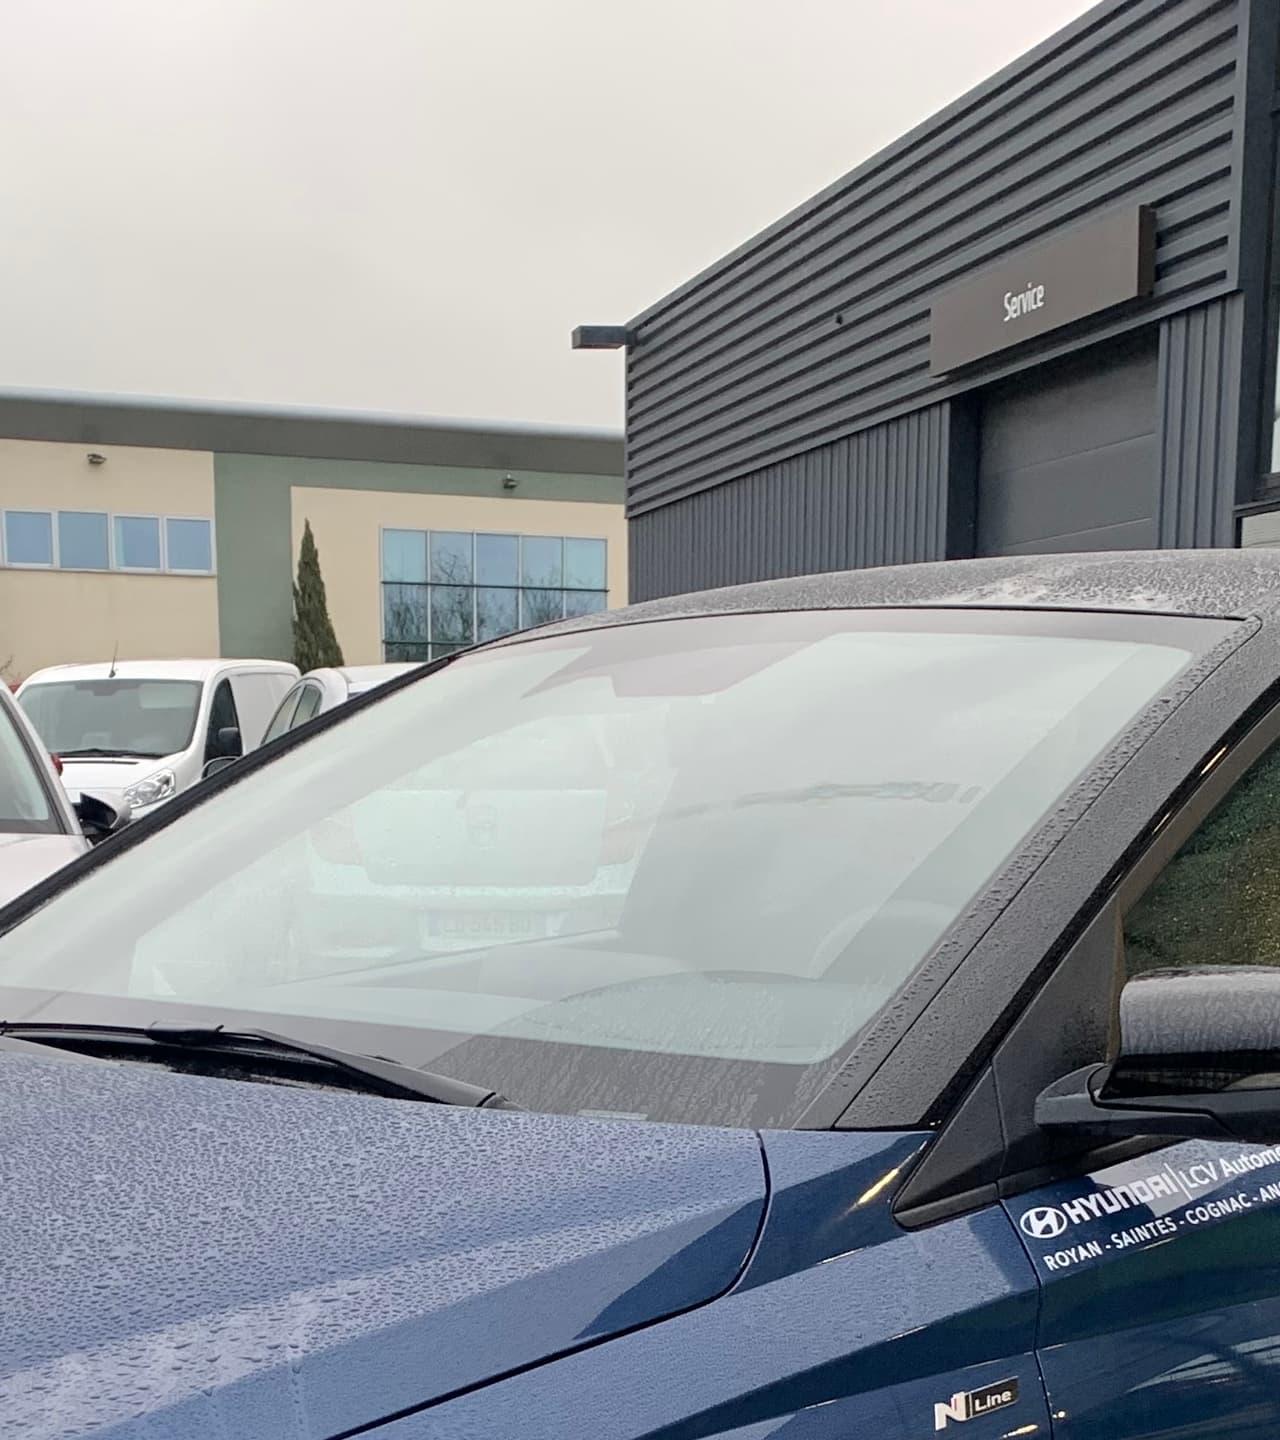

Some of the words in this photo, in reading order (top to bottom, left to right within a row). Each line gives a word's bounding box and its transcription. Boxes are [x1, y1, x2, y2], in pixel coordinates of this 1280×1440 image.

[1003, 281, 1045, 322] Service
[1061, 1171, 1179, 1225] HYUNDAI
[1178, 1160, 1219, 1189] LCV
[1042, 1240, 1103, 1271] ROYAN
[1110, 1216, 1178, 1249] SAINTES
[1184, 1192, 1252, 1225] COGNAC
[974, 1390, 1013, 1412] Line
